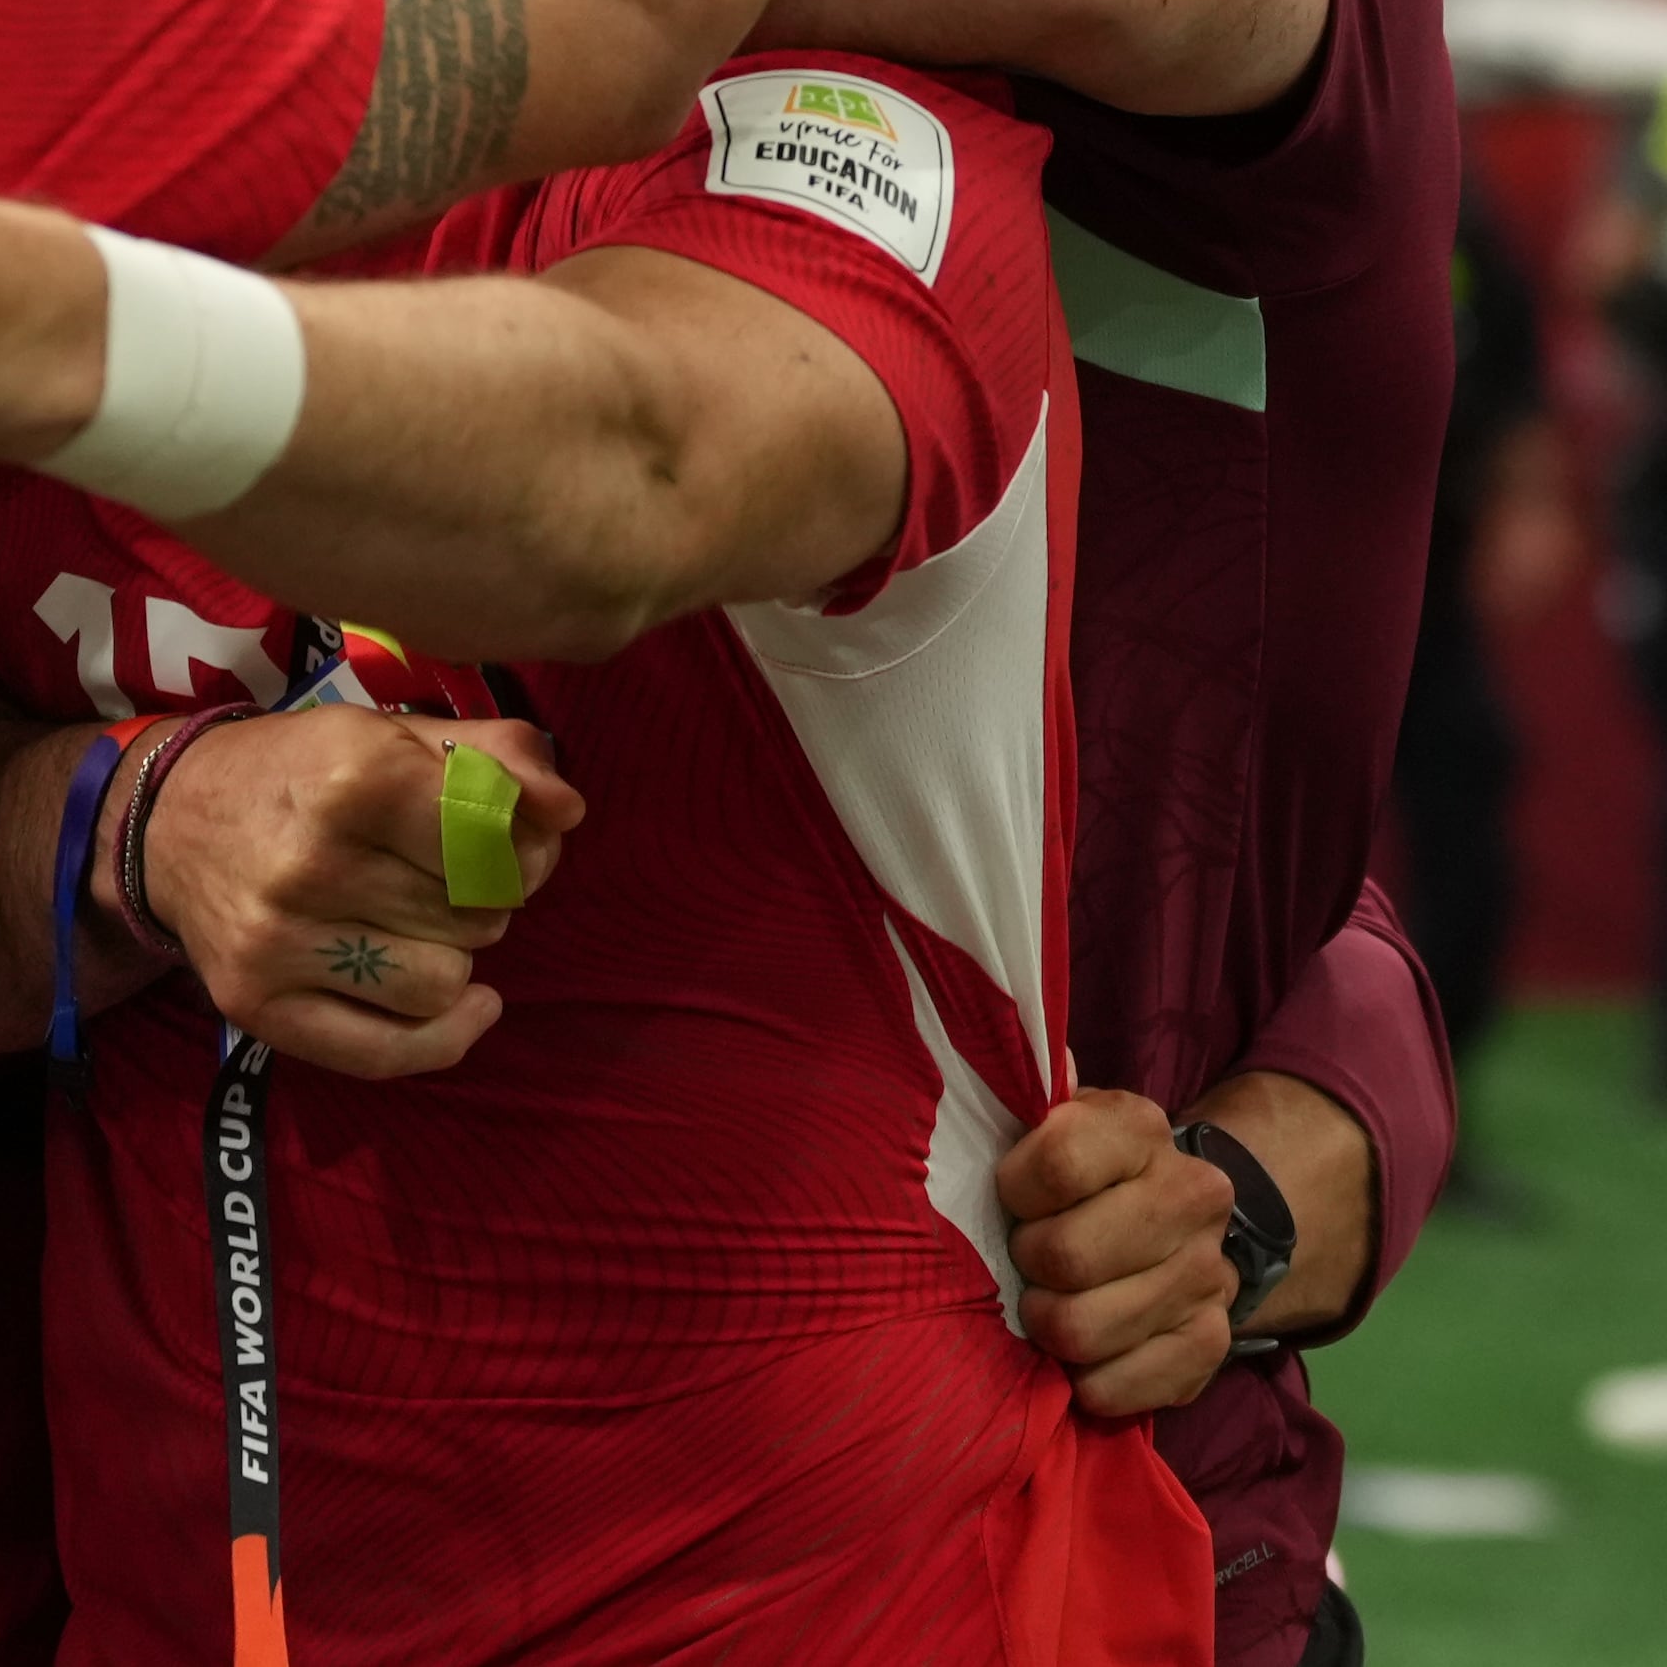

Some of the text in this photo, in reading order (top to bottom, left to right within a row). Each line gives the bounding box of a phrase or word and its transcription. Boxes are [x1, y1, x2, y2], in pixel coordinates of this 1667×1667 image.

[755, 141, 918, 224] EDUCATION
[808, 174, 865, 211] FIFA
[218, 1082, 253, 1182] CUP
[223, 1190, 266, 1365] WORLD
[239, 1379, 269, 1484] FIFA
[1215, 1540, 1276, 1589] RYCELL
